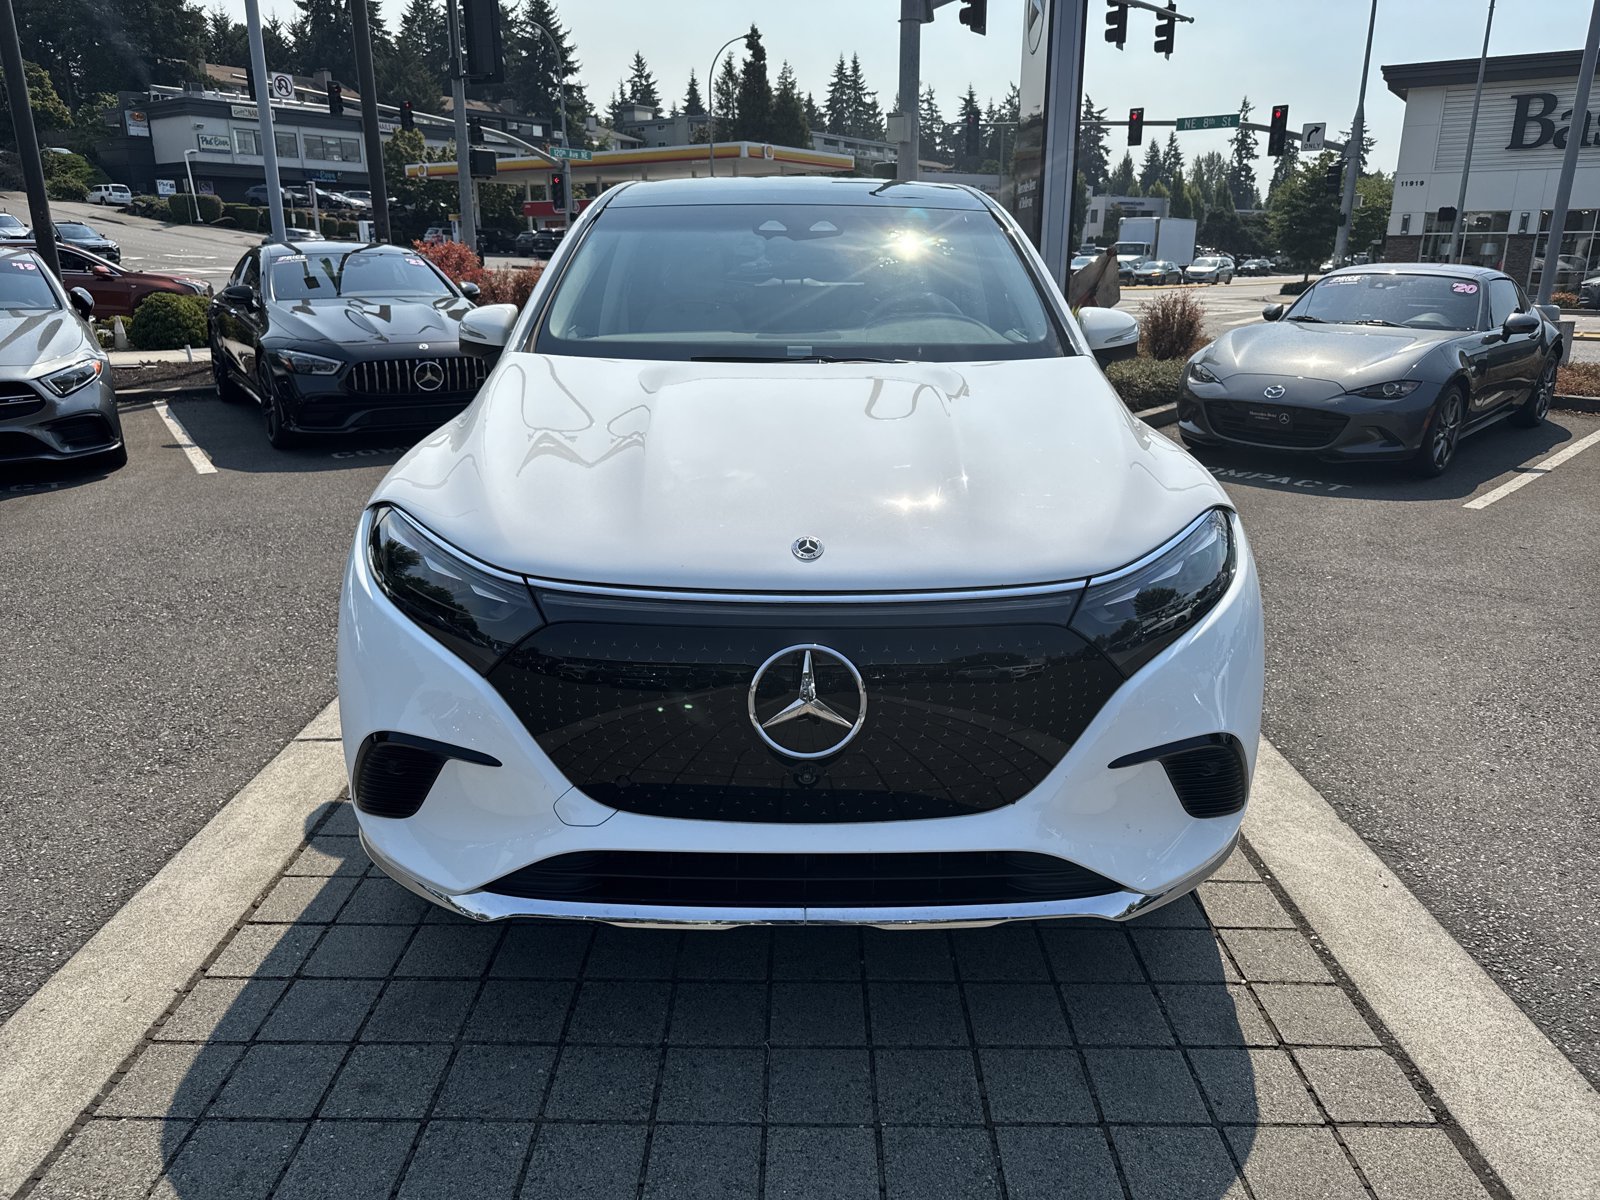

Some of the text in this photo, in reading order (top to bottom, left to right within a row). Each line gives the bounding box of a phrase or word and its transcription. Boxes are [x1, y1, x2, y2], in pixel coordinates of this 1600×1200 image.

[1184, 116, 1231, 129] NE 8th St
